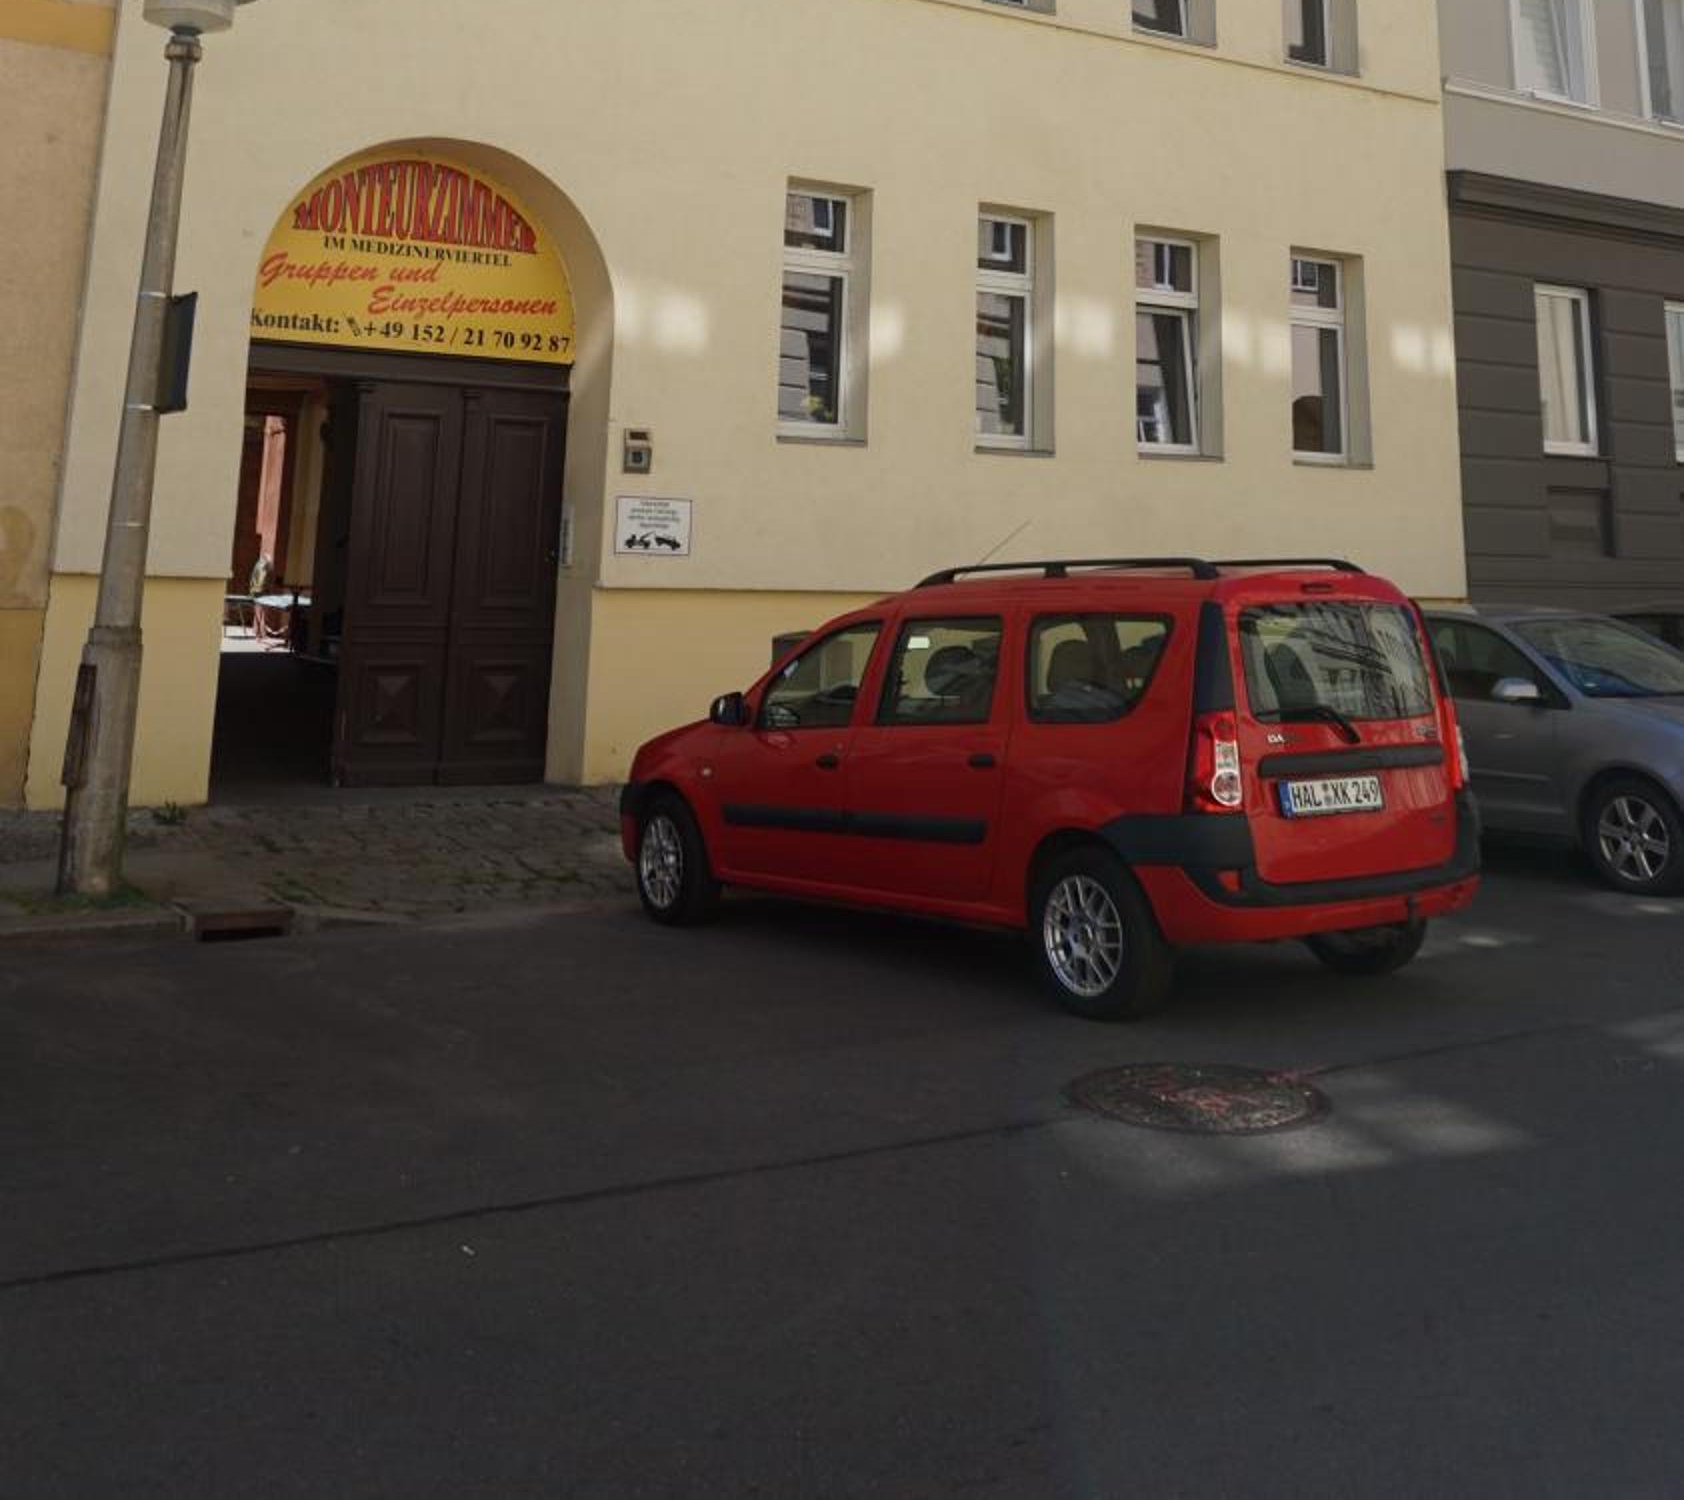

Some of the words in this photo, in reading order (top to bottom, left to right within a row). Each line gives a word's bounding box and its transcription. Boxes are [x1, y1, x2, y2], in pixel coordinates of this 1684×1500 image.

[292, 160, 537, 254] MONTEURZIMMER
[324, 236, 345, 250] IM
[351, 239, 513, 267] MEDIZINERVIERTEL
[260, 251, 379, 289] Gruppen
[389, 262, 442, 283] und
[367, 285, 558, 320] Einzelpersonen
[251, 307, 340, 334] Kontakt:
[412, 323, 445, 343] 152
[464, 327, 485, 346] 21
[493, 330, 515, 350] 70
[520, 333, 542, 352] 92
[548, 335, 571, 353] 87
[1291, 786, 1322, 809] HAL
[1351, 780, 1379, 804] 249
